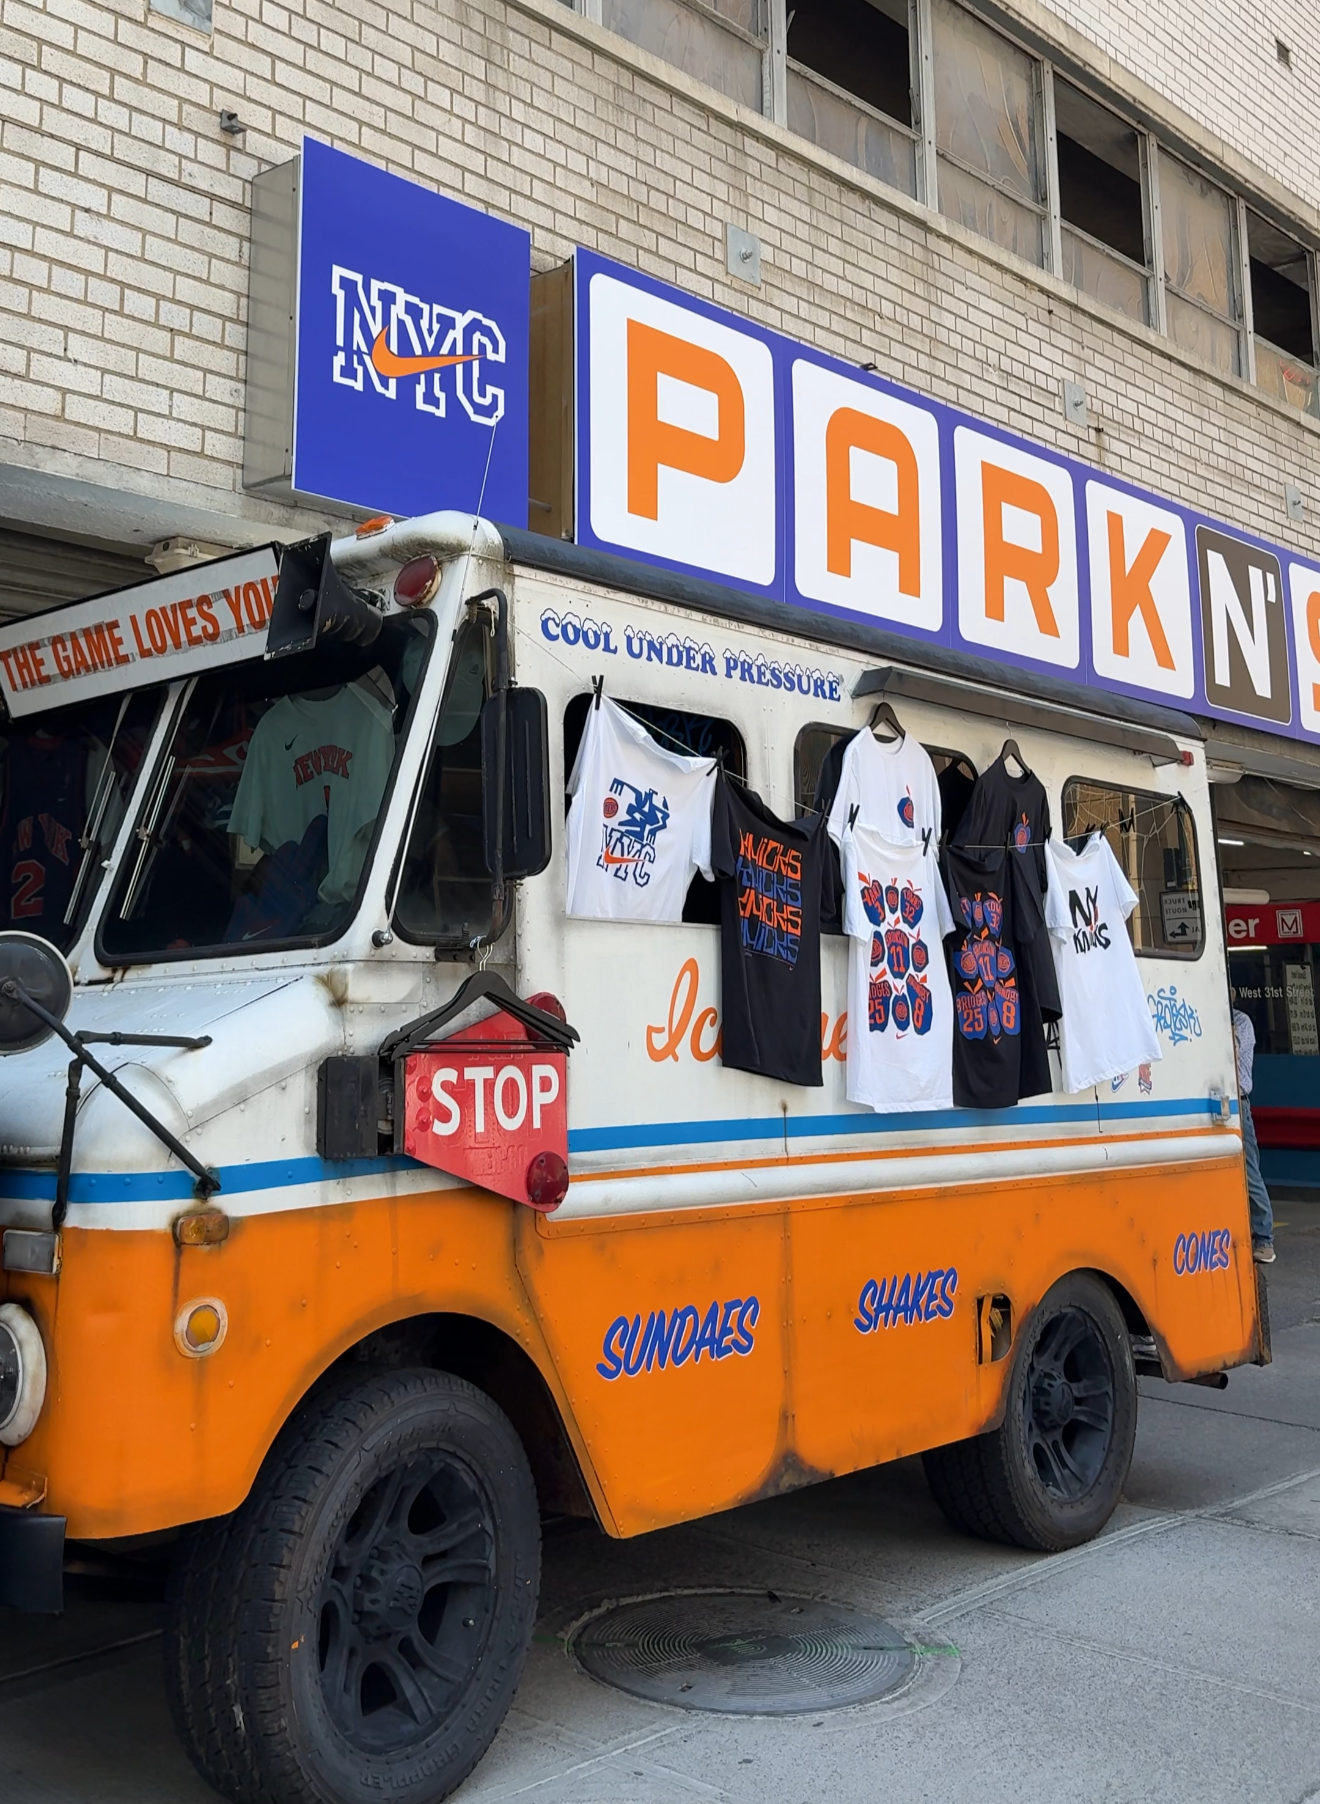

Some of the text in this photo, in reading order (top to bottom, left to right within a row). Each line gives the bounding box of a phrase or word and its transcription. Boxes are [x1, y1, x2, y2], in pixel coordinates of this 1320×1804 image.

[332, 264, 506, 427] NYC
[627, 316, 1177, 672] PARK
[0, 638, 52, 692] THE
[51, 620, 132, 676] GAME
[130, 594, 220, 659] LOVES
[541, 608, 842, 702] COOL UNDER PRESSURE
[902, 902, 916, 923] 32
[1228, 917, 1261, 940] er
[889, 946, 906, 973] 11
[978, 954, 995, 982] 11
[1238, 986, 1262, 998] West
[1264, 986, 1284, 998] 31st
[1286, 985, 1315, 998] Street
[913, 997, 925, 1029] 8
[962, 1007, 985, 1033] 25
[1001, 1000, 1017, 1030] 8
[430, 1064, 560, 1137] STOP
[1172, 1226, 1232, 1277] CONES
[852, 1266, 959, 1335] SHAKES
[596, 1295, 760, 1382] SUNDAES
